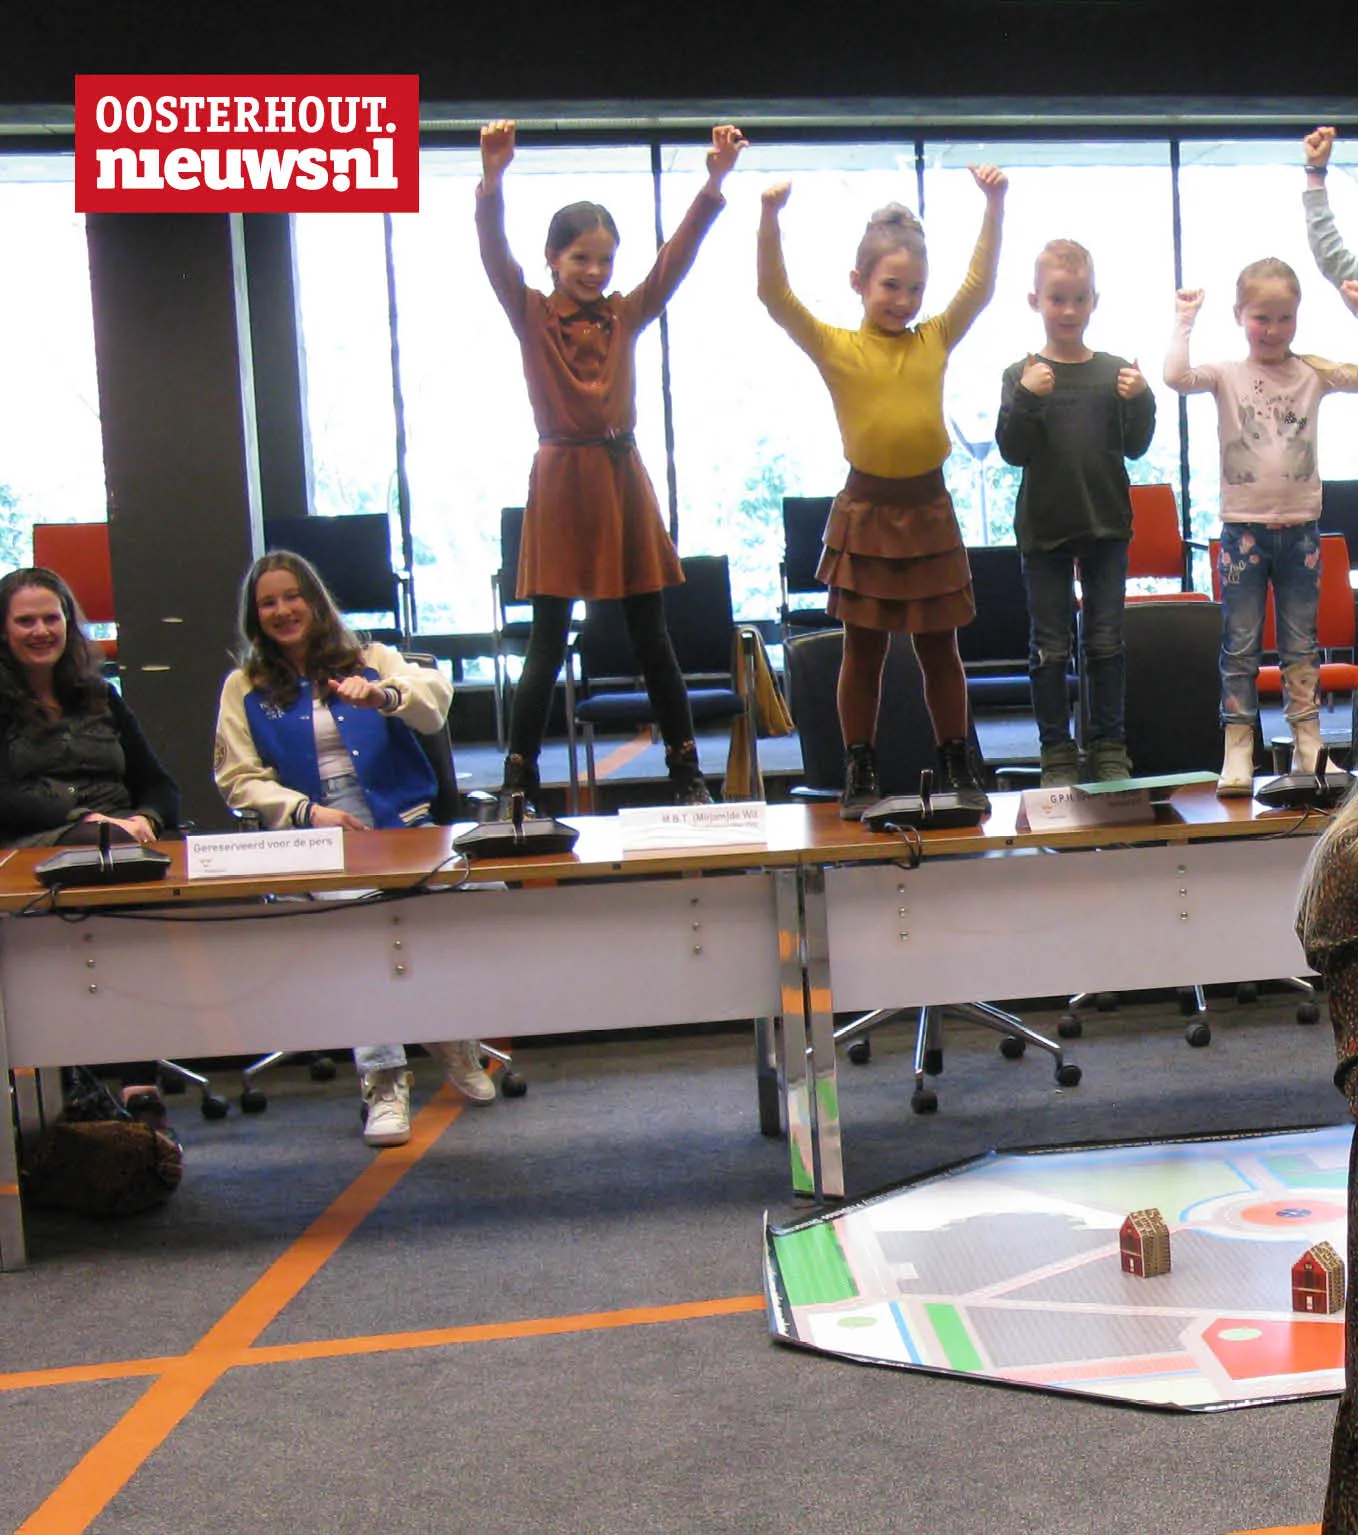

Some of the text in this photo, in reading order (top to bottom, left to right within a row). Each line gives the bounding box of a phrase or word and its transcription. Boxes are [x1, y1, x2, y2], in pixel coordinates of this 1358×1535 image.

[193, 836, 333, 853] Gereserveerd voor de pers
